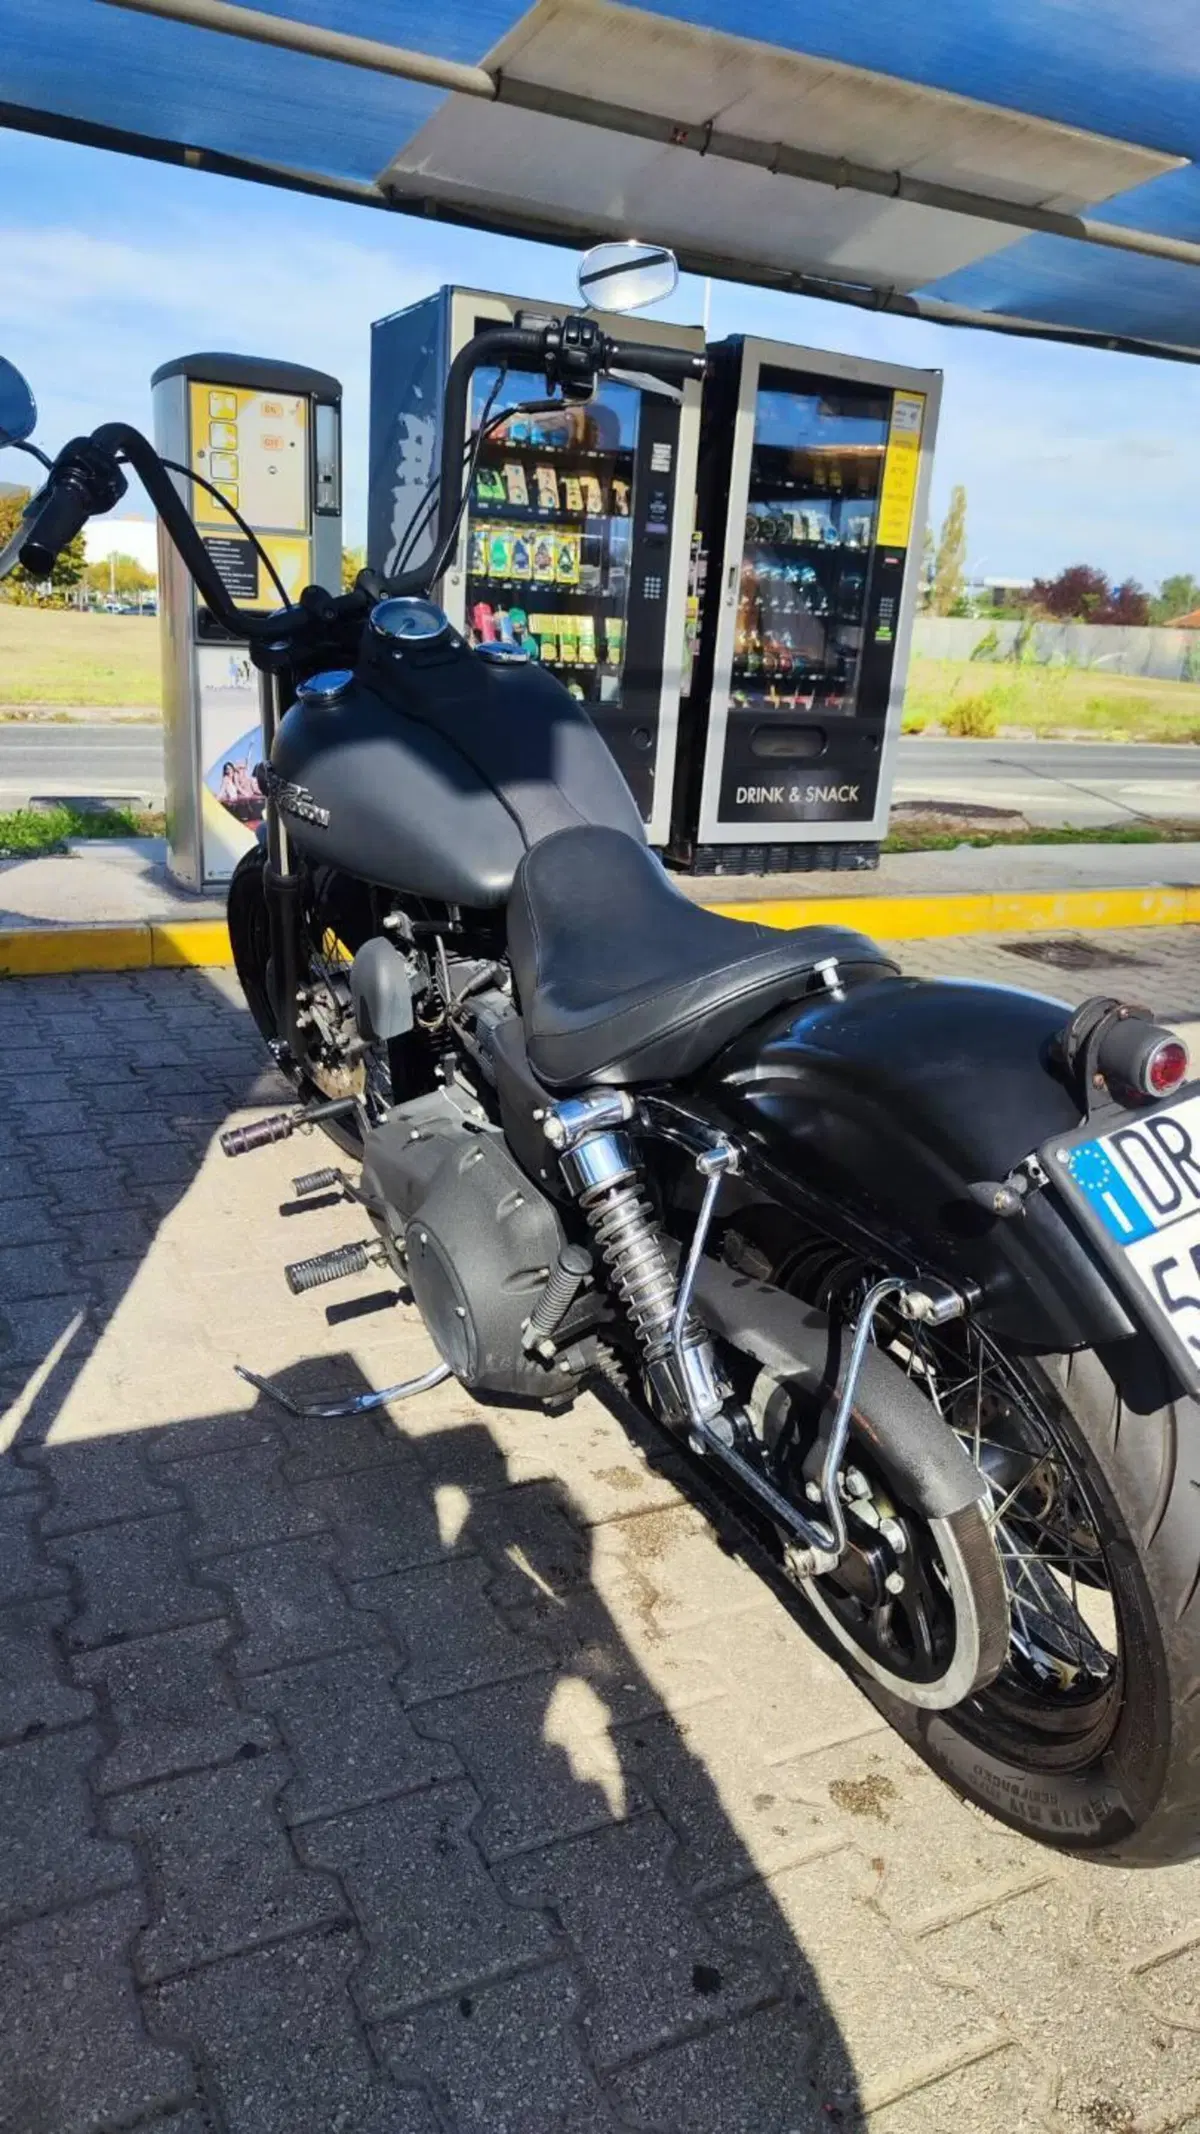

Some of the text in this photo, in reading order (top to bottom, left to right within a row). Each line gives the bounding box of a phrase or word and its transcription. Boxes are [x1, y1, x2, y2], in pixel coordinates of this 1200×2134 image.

[736, 785, 860, 804] DRINK & SNACK
[1109, 1116, 1200, 1214] DR
[1152, 1242, 1200, 1353] 5
